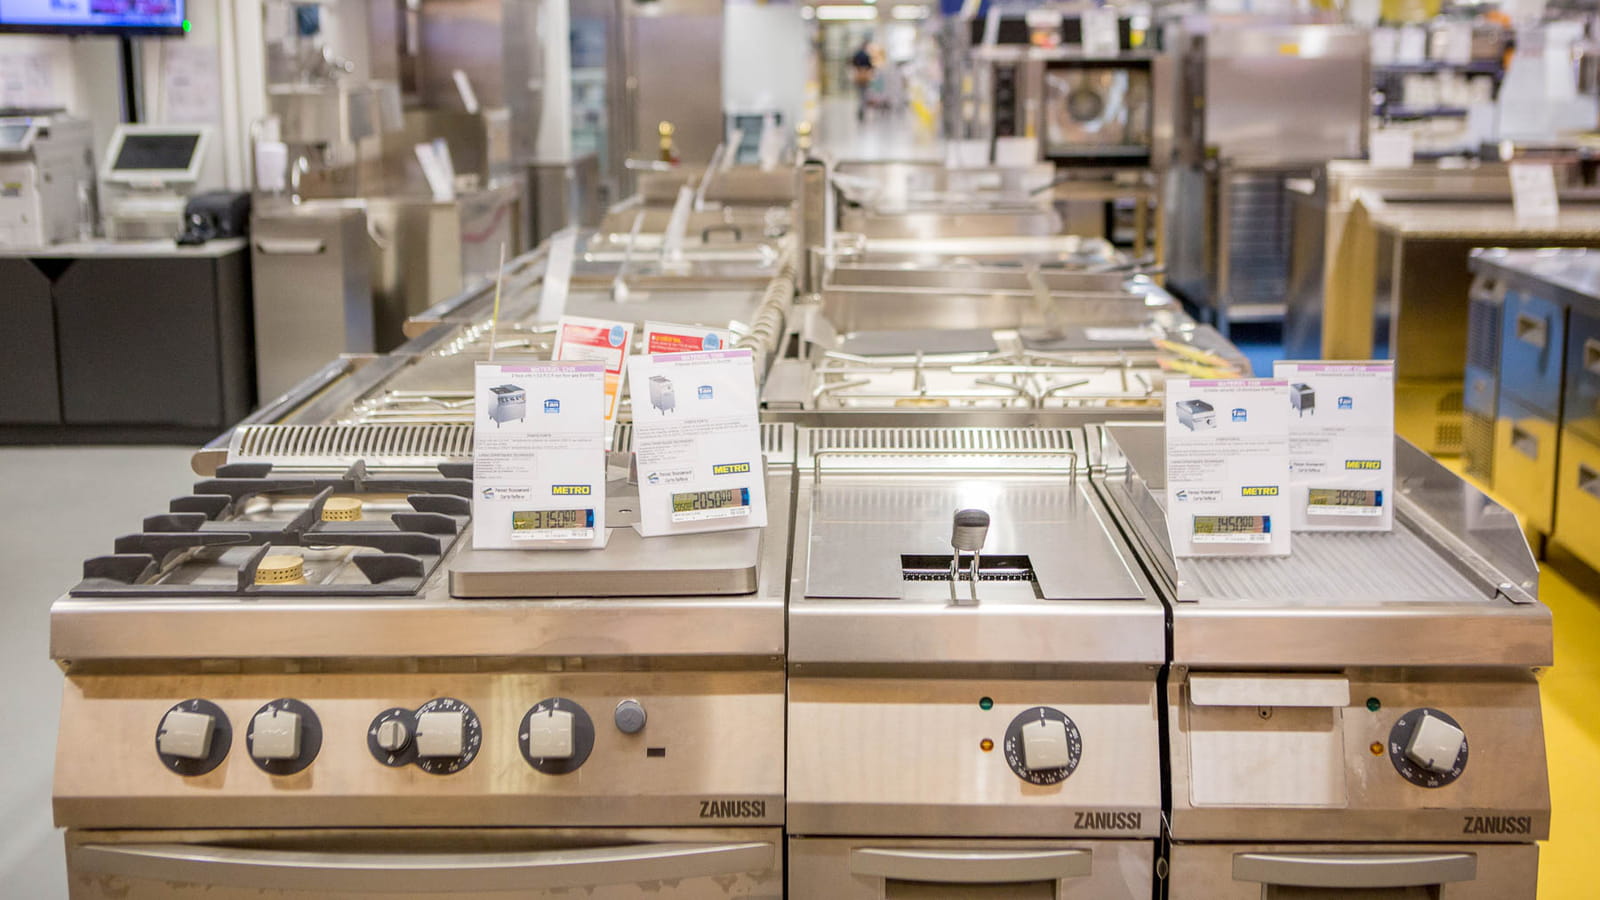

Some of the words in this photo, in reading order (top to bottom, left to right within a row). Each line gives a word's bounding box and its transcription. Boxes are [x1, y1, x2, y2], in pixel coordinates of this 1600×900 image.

[714, 463, 749, 474] METRO
[1346, 461, 1380, 469] METRO
[553, 486, 590, 495] METRO
[1243, 487, 1277, 496] METRO
[699, 800, 766, 818] ZANUSSI
[1073, 811, 1142, 830] ZANUSSI
[1463, 815, 1532, 834] ZANUSSI
